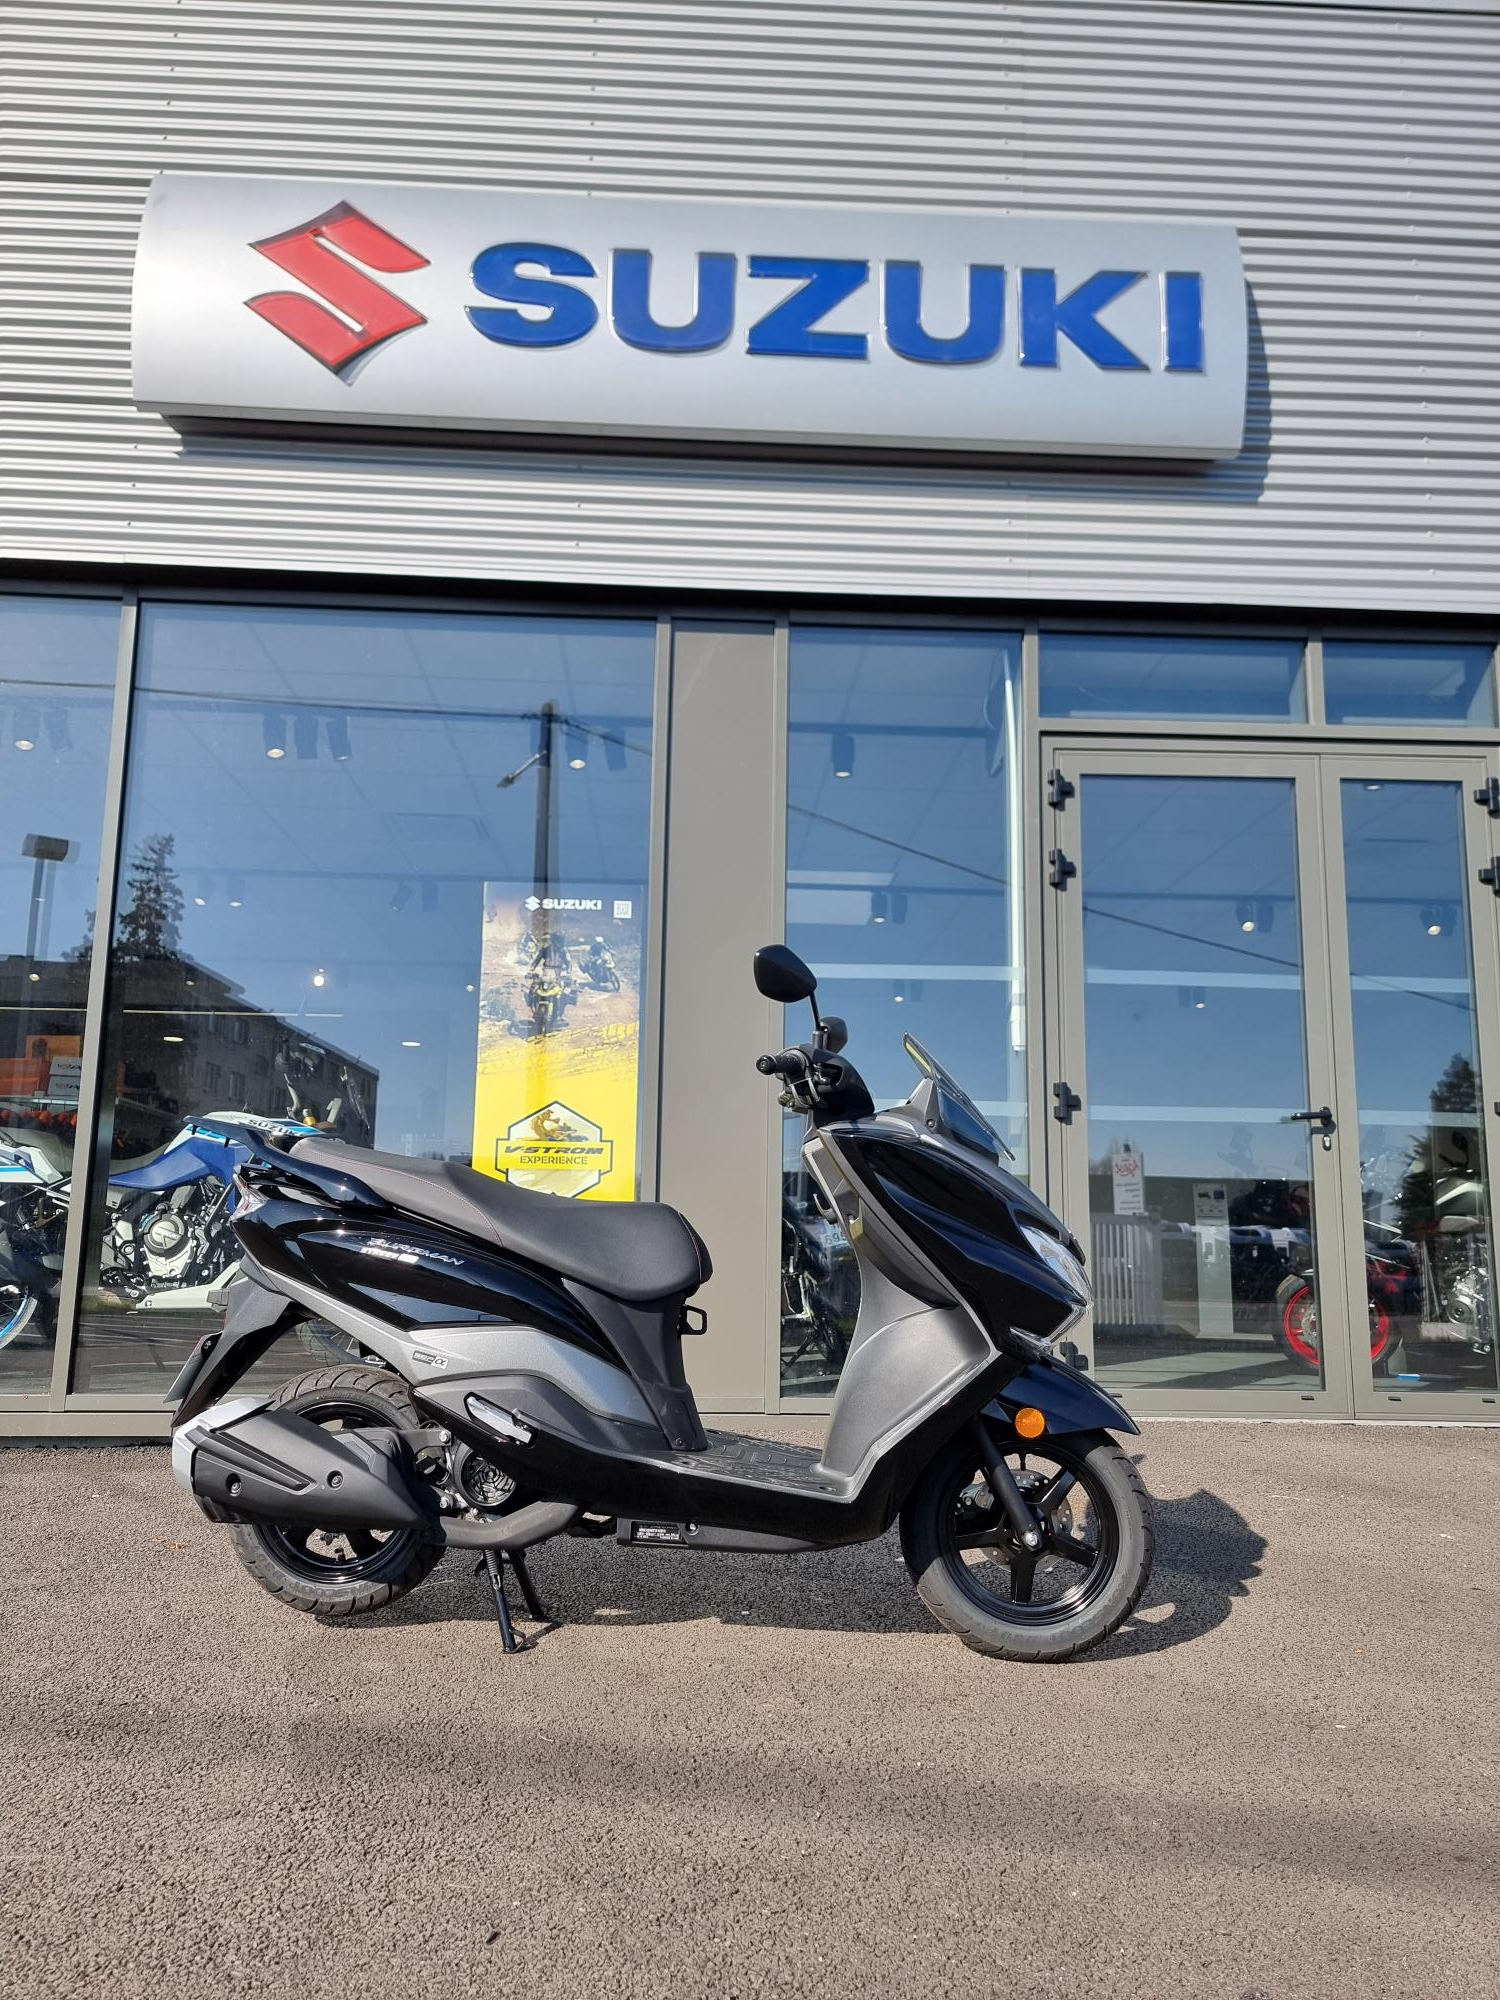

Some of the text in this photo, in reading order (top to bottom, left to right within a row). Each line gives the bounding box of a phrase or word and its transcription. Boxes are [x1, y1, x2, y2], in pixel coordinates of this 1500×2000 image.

[464, 241, 1204, 373] SUZUKI
[541, 898, 602, 911] SUZUKI
[504, 1145, 604, 1155] V-STROM
[519, 1155, 588, 1165] EXPERIENCE
